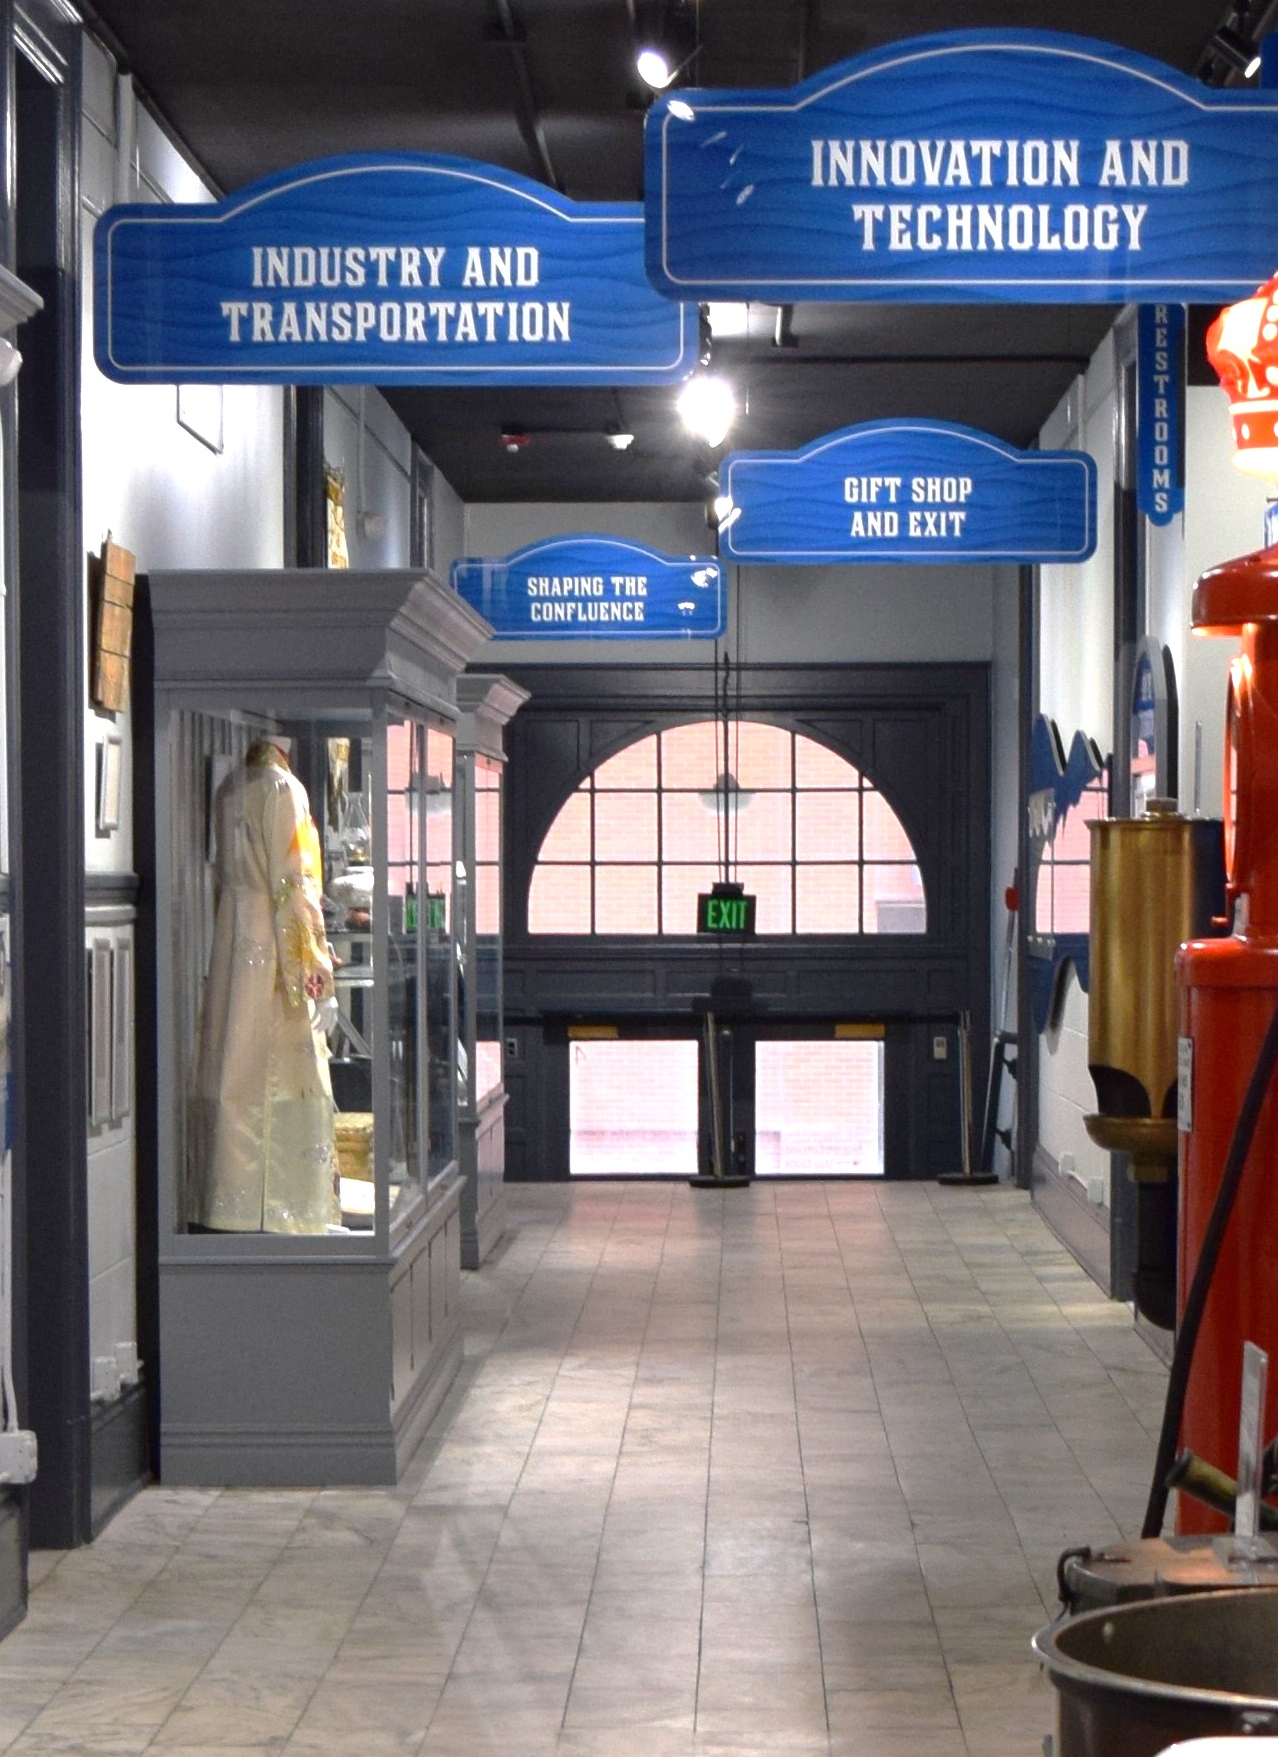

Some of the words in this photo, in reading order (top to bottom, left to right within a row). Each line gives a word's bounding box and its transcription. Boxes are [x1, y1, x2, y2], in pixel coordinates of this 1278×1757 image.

[811, 139, 1080, 186] INNOVATION
[1099, 139, 1189, 186] AND
[851, 203, 1148, 251] TECHNOLOGY
[252, 246, 446, 287] INDUSTRY
[462, 246, 540, 287] AND
[221, 301, 571, 342] TRANSPORTATION
[1152, 303, 1171, 514] RESTROOMS
[843, 476, 903, 503] GIFT
[911, 476, 973, 503] SHOP
[850, 510, 899, 537] AND
[908, 510, 967, 537] EXIT
[527, 575, 603, 597] SHAPING
[610, 575, 648, 597] THE
[530, 601, 645, 622] CONFLUENCE
[707, 899, 748, 930] EXIT
